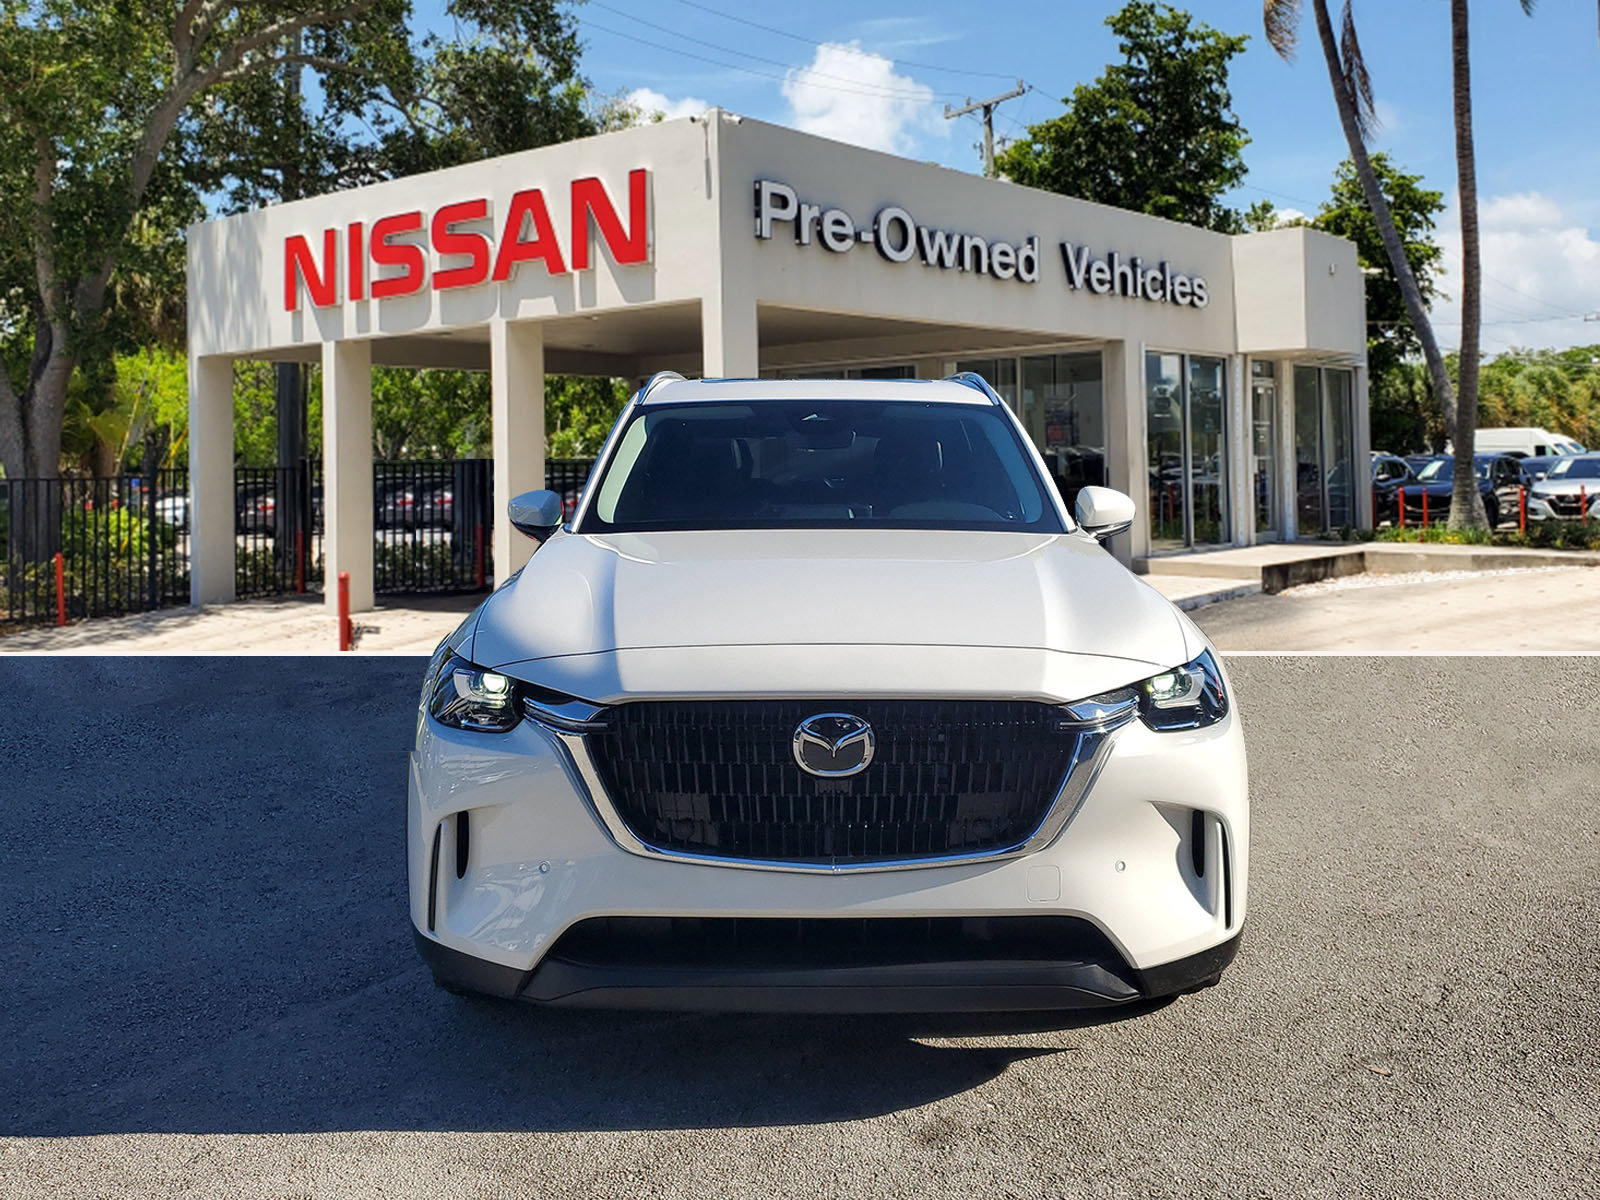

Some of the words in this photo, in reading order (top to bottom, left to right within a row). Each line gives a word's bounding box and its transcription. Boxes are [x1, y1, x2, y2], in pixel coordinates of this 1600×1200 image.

[284, 168, 651, 312] NISSAN
[754, 180, 1040, 283] Pre-Owned
[1060, 241, 1209, 308] Vehicles
